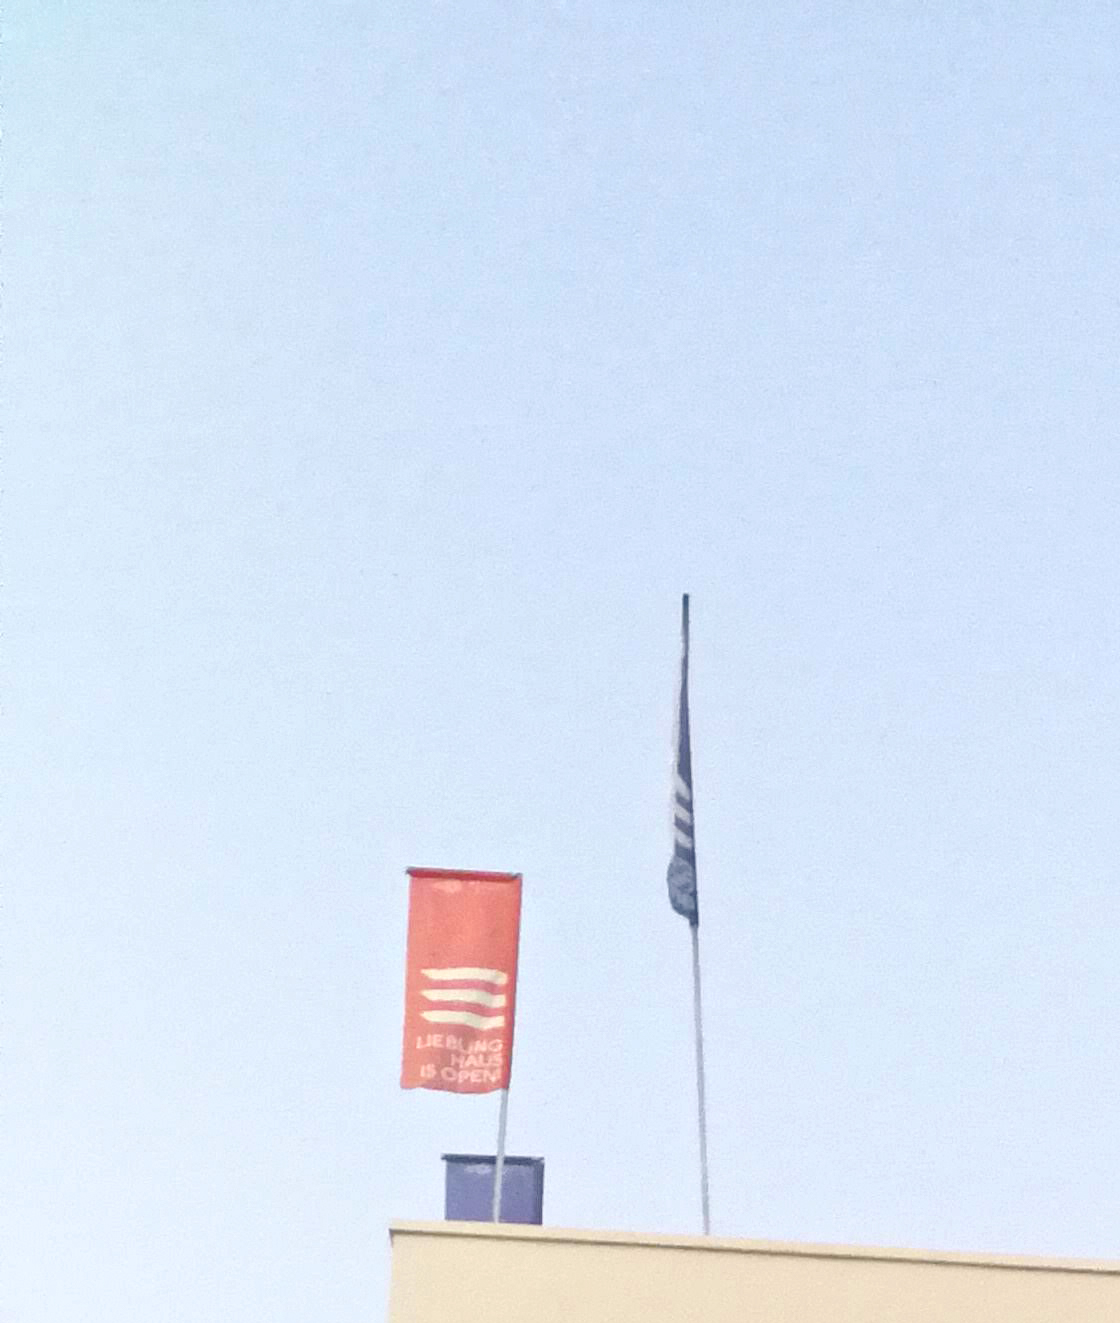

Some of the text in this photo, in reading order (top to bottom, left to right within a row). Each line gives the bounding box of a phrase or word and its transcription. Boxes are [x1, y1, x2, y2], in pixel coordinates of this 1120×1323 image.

[416, 1033, 503, 1055] LIEBLING
[450, 1053, 503, 1068] HAUS
[420, 1063, 502, 1083] IS OPEN
